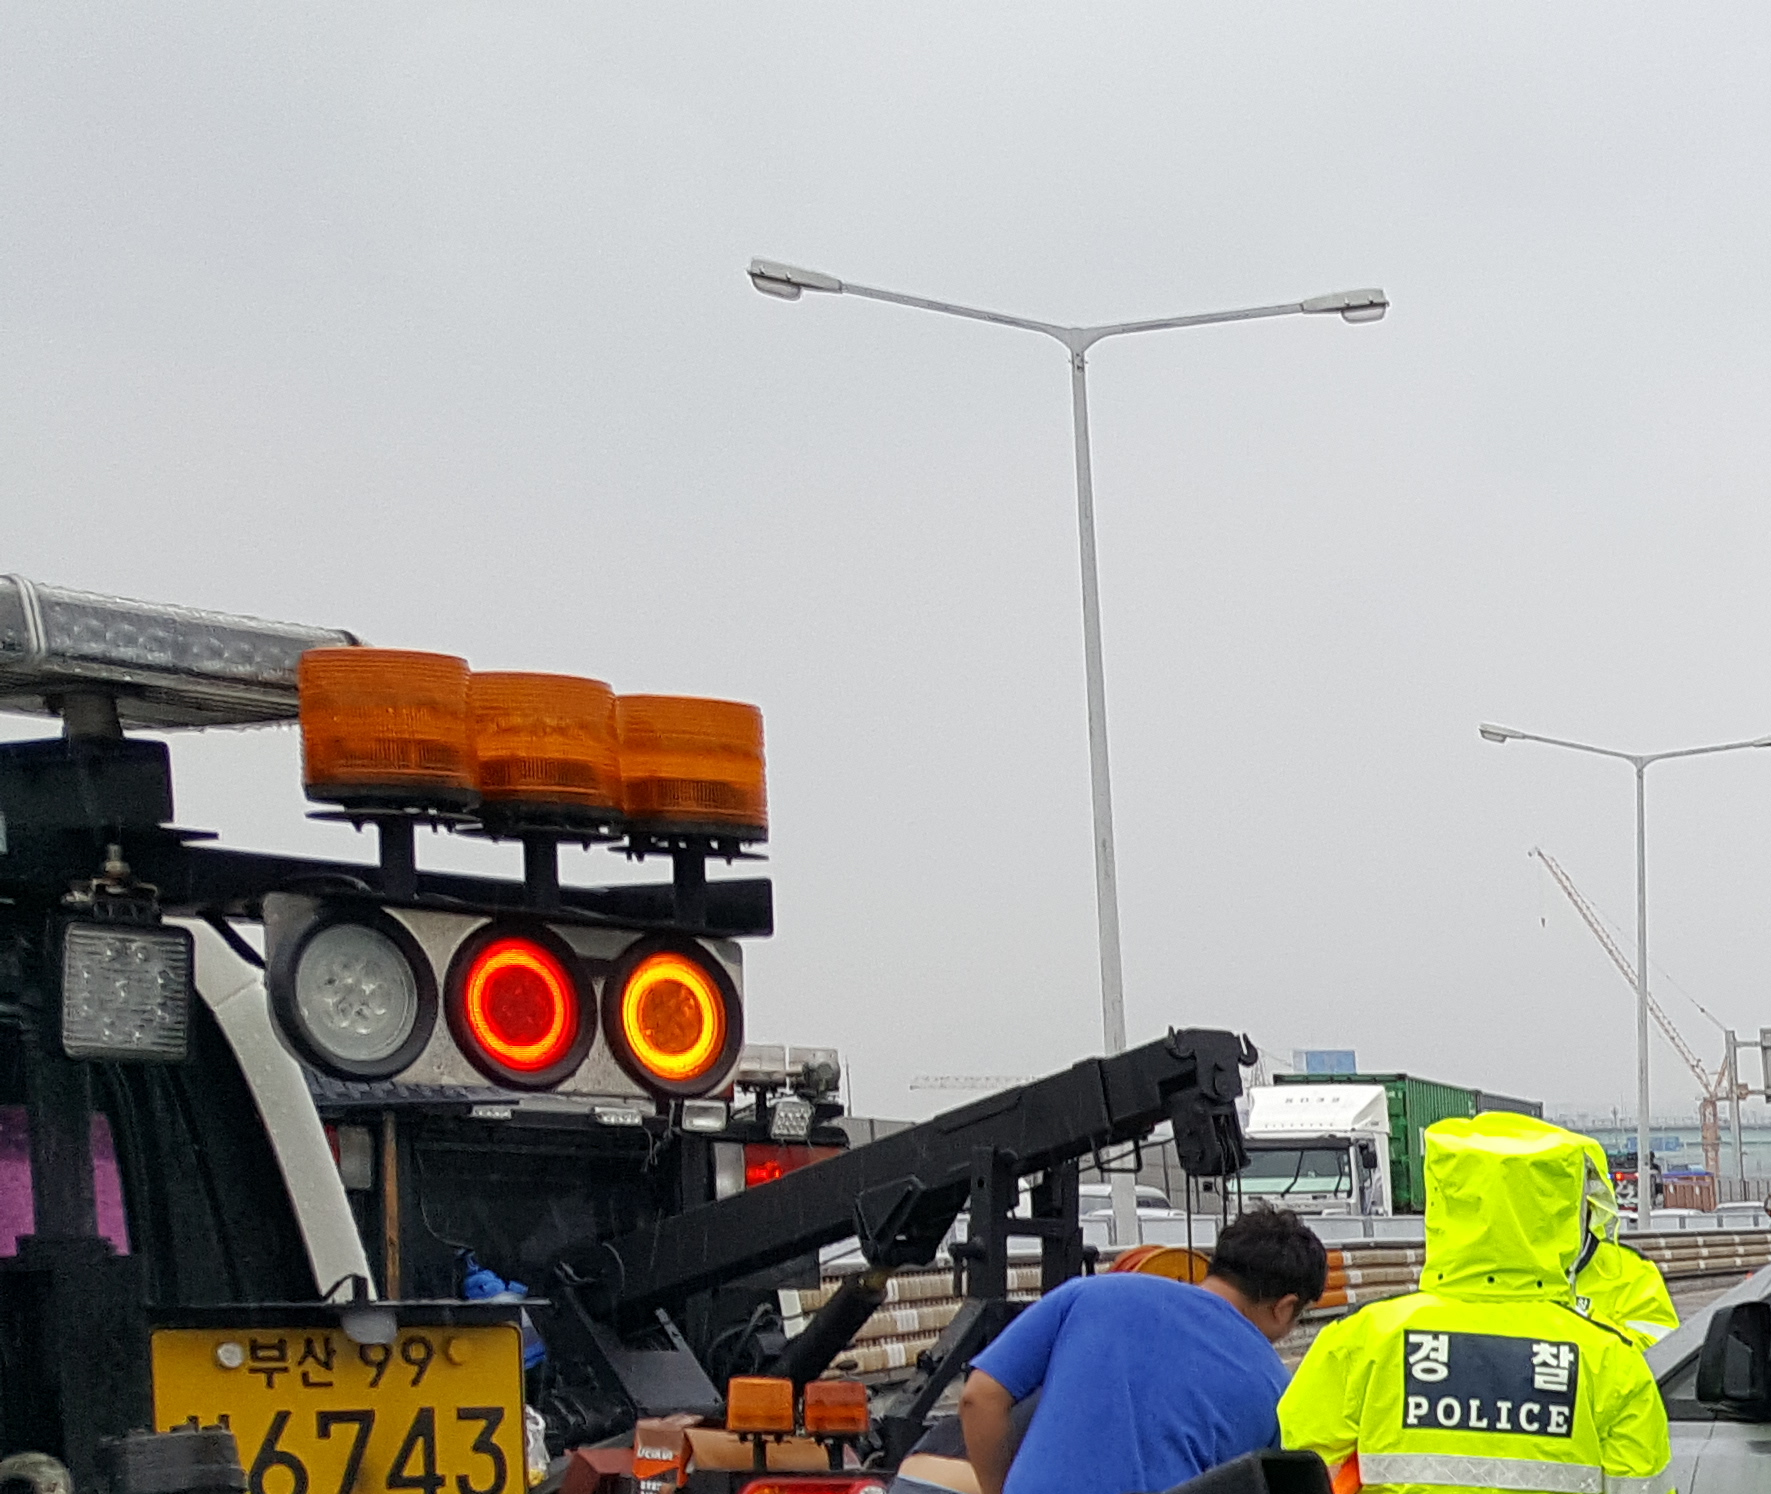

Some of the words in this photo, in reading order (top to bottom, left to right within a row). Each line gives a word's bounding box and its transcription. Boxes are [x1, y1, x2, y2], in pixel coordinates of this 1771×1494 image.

[248, 1335, 337, 1390] 부산
[358, 1335, 435, 1388] 99
[1406, 1395, 1570, 1435] POLICE
